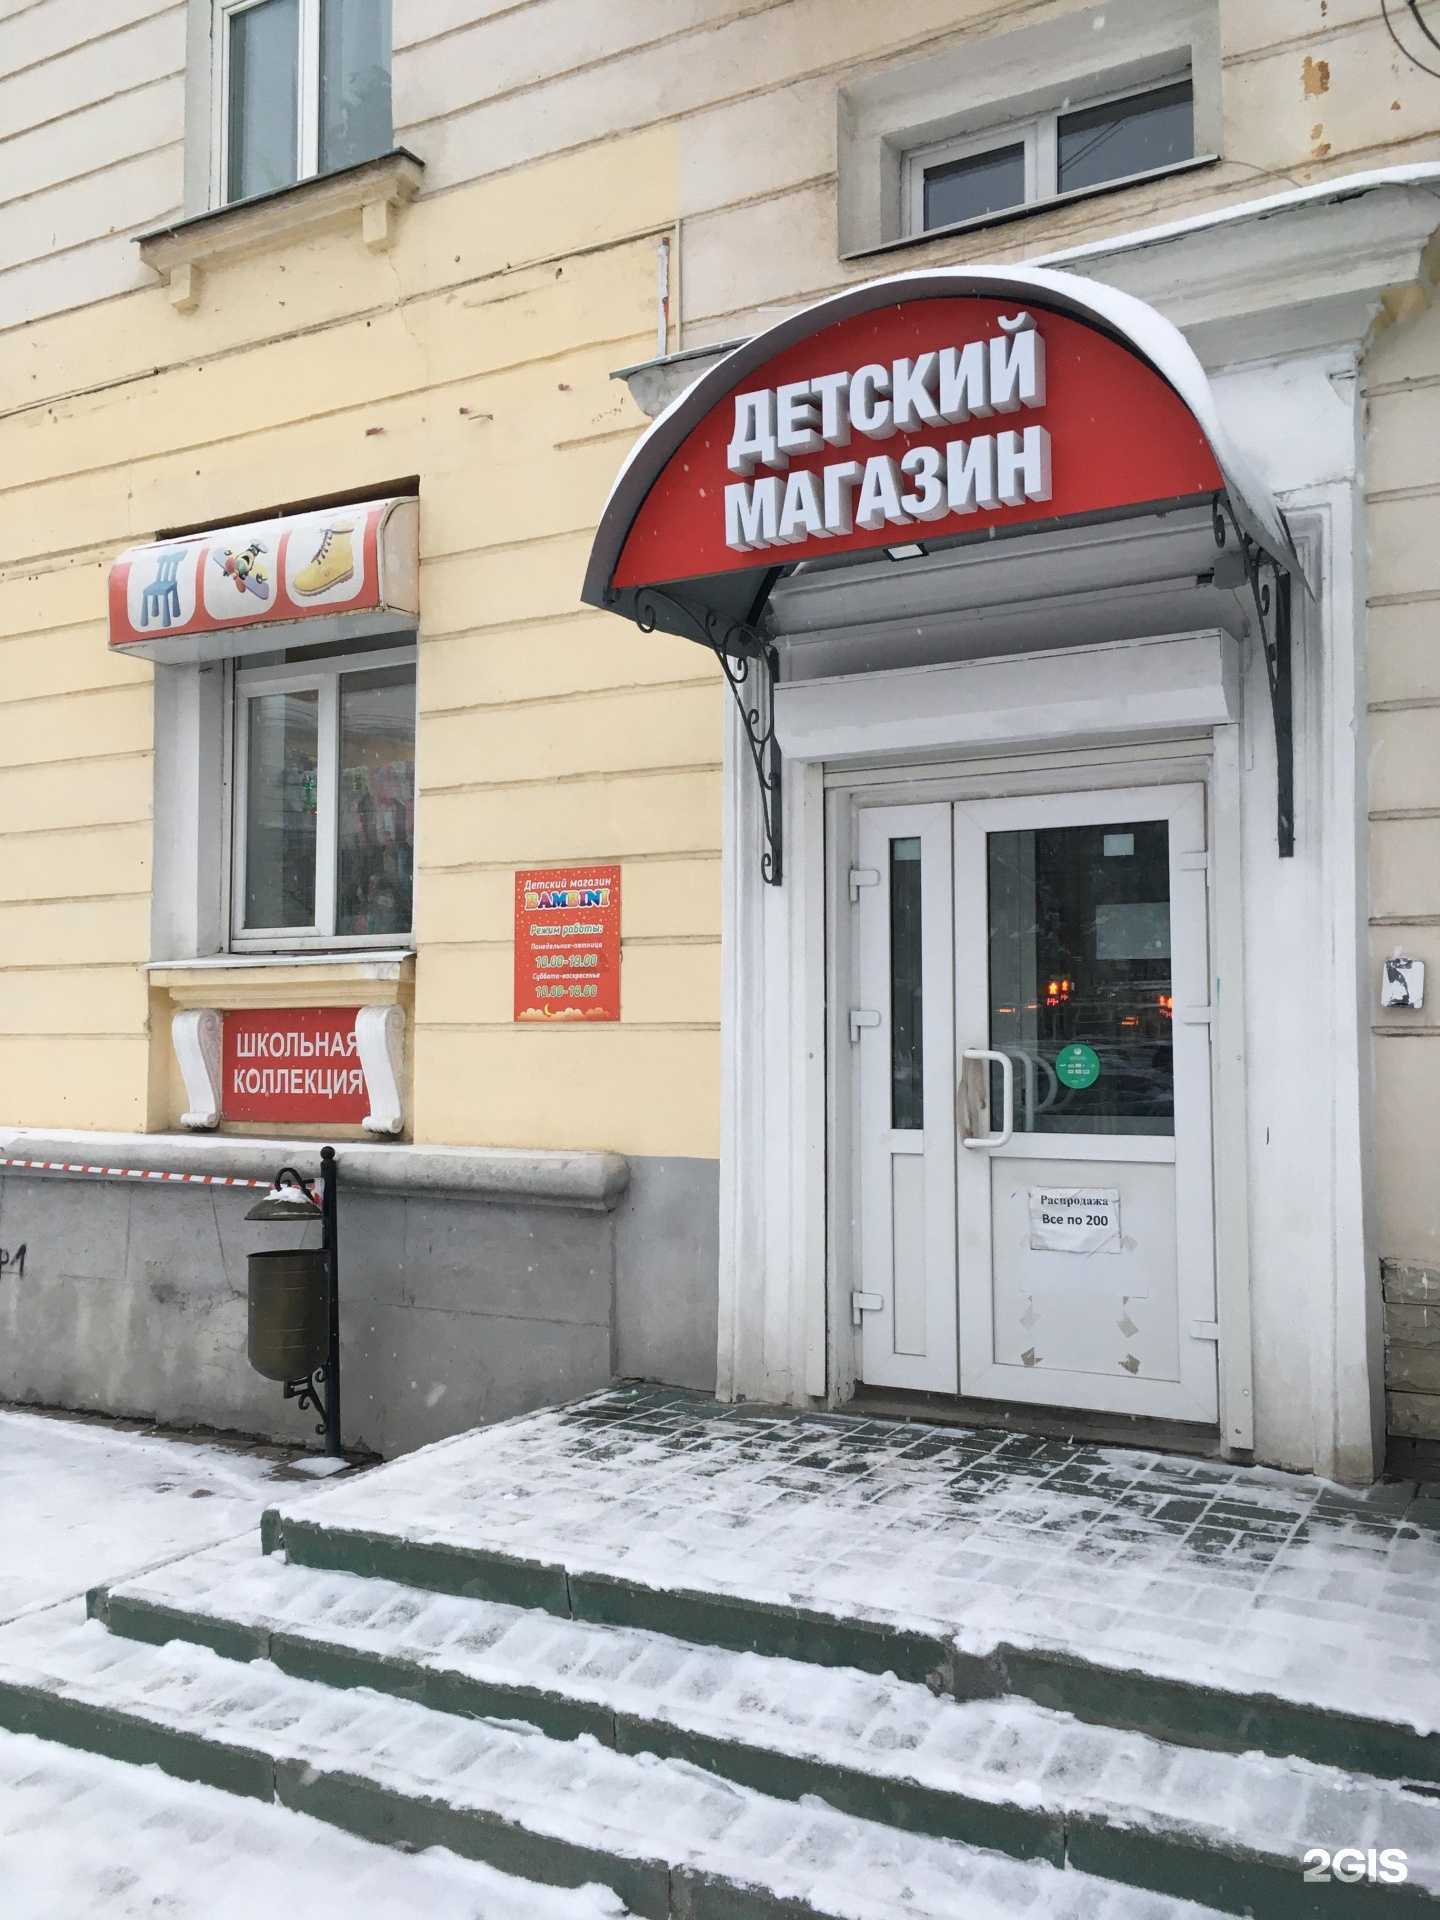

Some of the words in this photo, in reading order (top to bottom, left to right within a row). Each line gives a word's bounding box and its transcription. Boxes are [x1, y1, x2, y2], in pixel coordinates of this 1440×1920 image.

[726, 312, 1046, 474] ДЕТСКИЙ
[724, 425, 1052, 553] МАГАЗИН
[524, 879, 567, 891] Детский
[569, 878, 611, 889] магазин
[525, 888, 610, 911] BAMBINI
[530, 924, 560, 936] Режим
[236, 1032, 360, 1057] ШКОЛЬНАЯ
[233, 1068, 364, 1099] КОЛЛЕКЦИЯ
[1040, 1195, 1109, 1207] Распродажа
[1042, 1213, 1064, 1225] Все
[1067, 1216, 1083, 1225] по
[1086, 1215, 1109, 1226] 200
